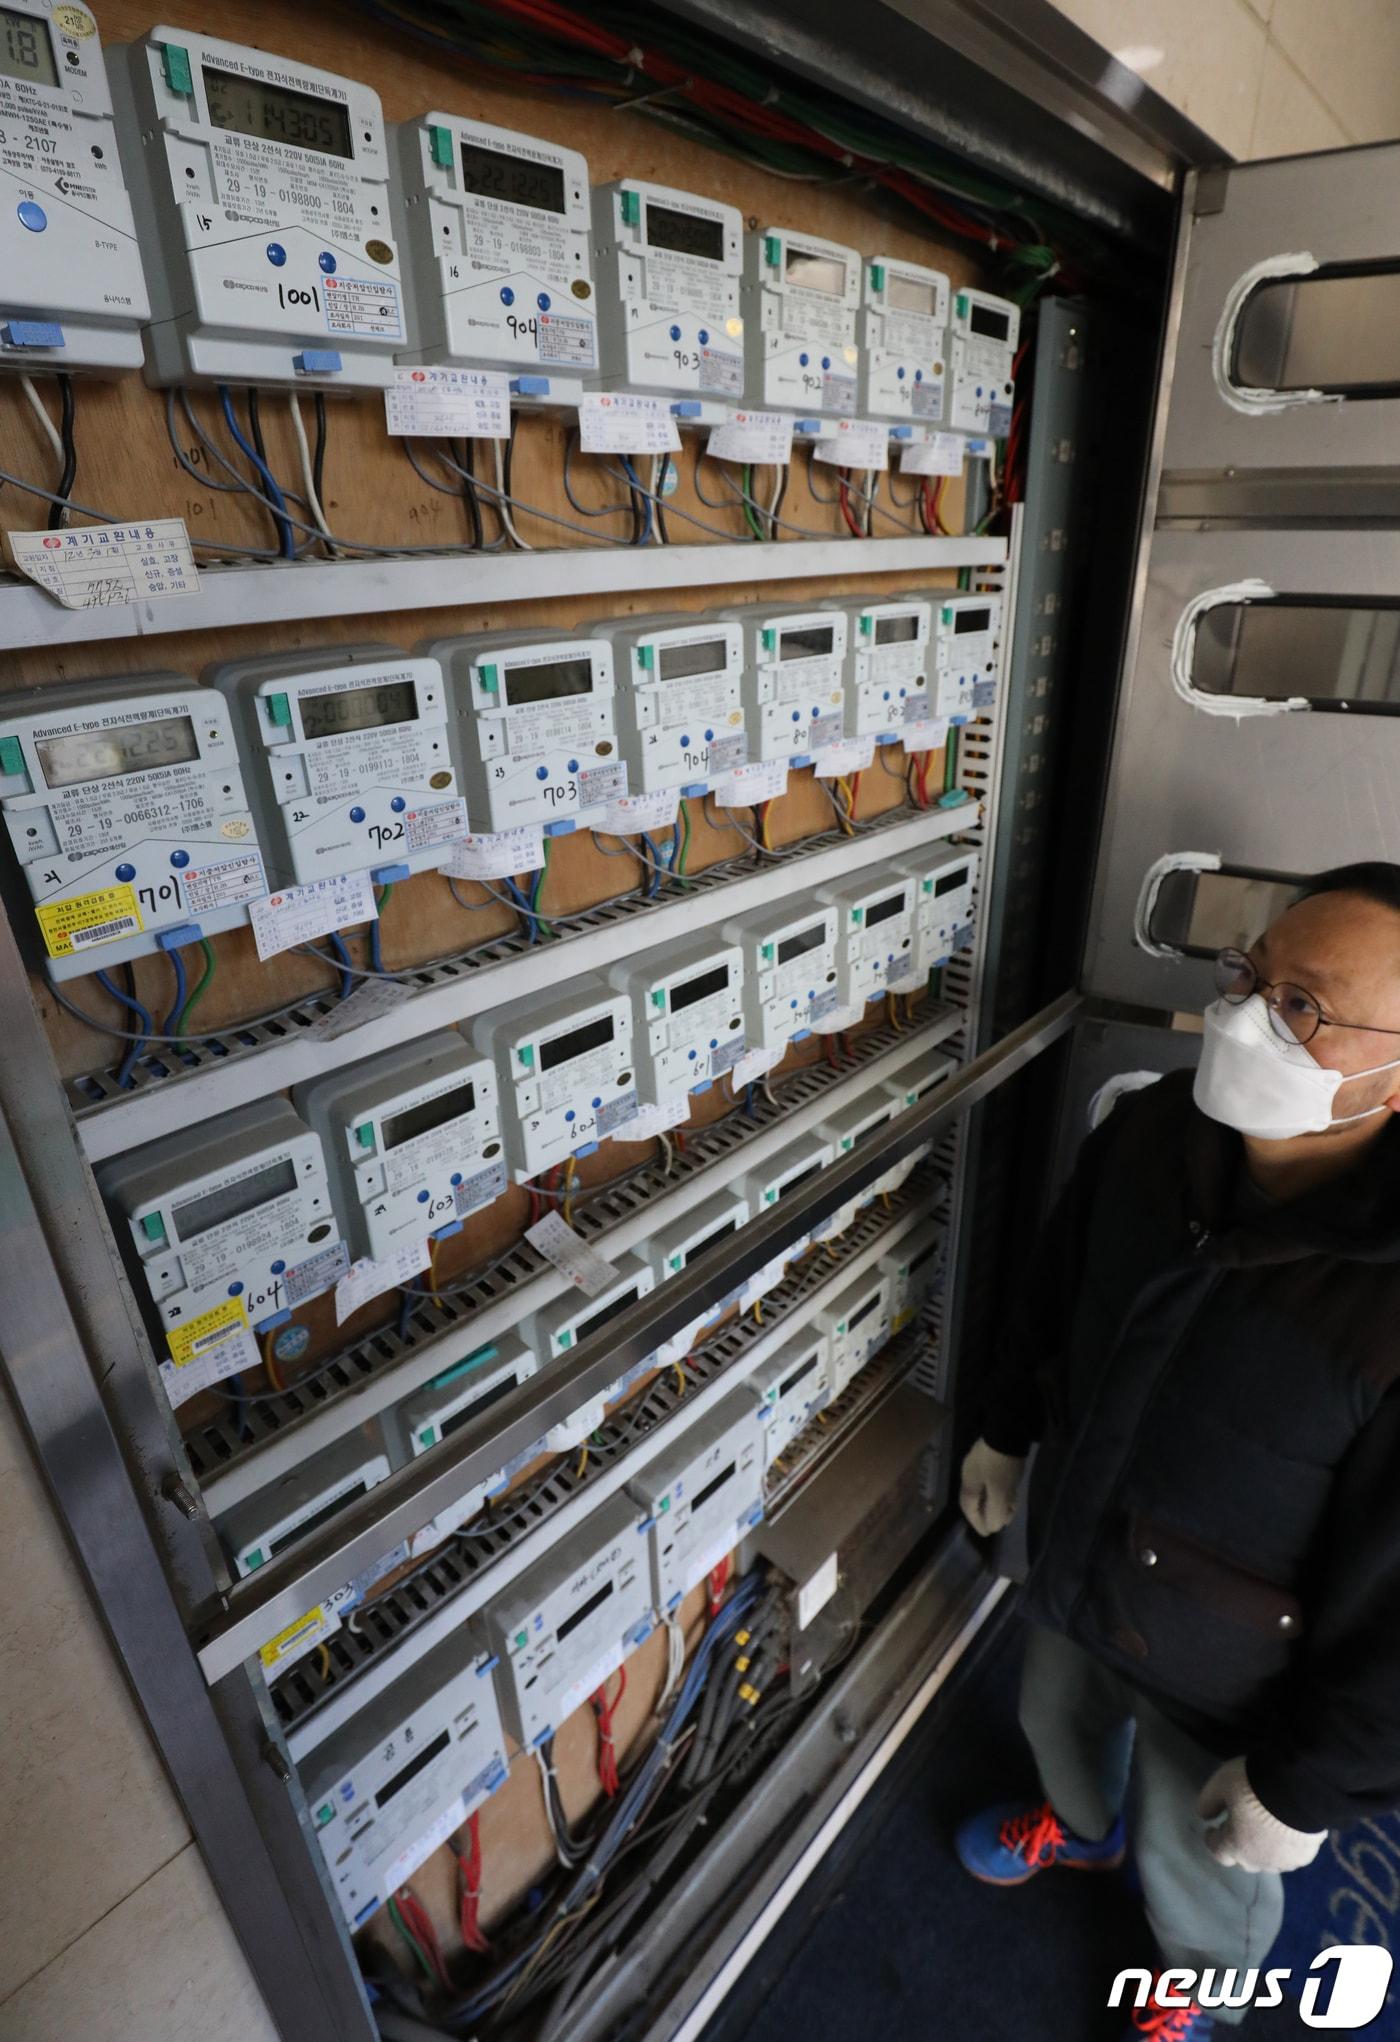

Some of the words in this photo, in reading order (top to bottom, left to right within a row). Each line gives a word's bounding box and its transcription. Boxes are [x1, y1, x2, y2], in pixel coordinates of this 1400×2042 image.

[201, 52, 239, 71] Advanced
[15, 82, 37, 96] 60Hz
[24, 135, 57, 154] 2107
[224, 134, 241, 147] 교류
[243, 138, 260, 152] 단상
[284, 148, 303, 161] 220V
[226, 178, 241, 193] 29
[253, 184, 267, 198] 19
[332, 200, 355, 215] 1804
[196, 214, 212, 231] 15
[450, 265, 459, 279] 16
[278, 283, 320, 313] 1001
[506, 314, 538, 349] 904
[673, 350, 700, 370] 903
[32, 724, 73, 739] Advanced
[74, 720, 100, 733] E-type
[683, 747, 709, 772] 704
[62, 788, 80, 799] 교류
[82, 785, 99, 795] 단상
[101, 780, 124, 791] 2선식
[126, 776, 145, 788] 220V
[543, 781, 577, 807] 703
[67, 825, 83, 838] 29
[98, 818, 112, 831] 19
[368, 822, 406, 850] 702
[138, 875, 182, 913] 701
[570, 1118, 597, 1140] 602
[428, 1195, 454, 1220] 603
[247, 1281, 283, 1313] 604
